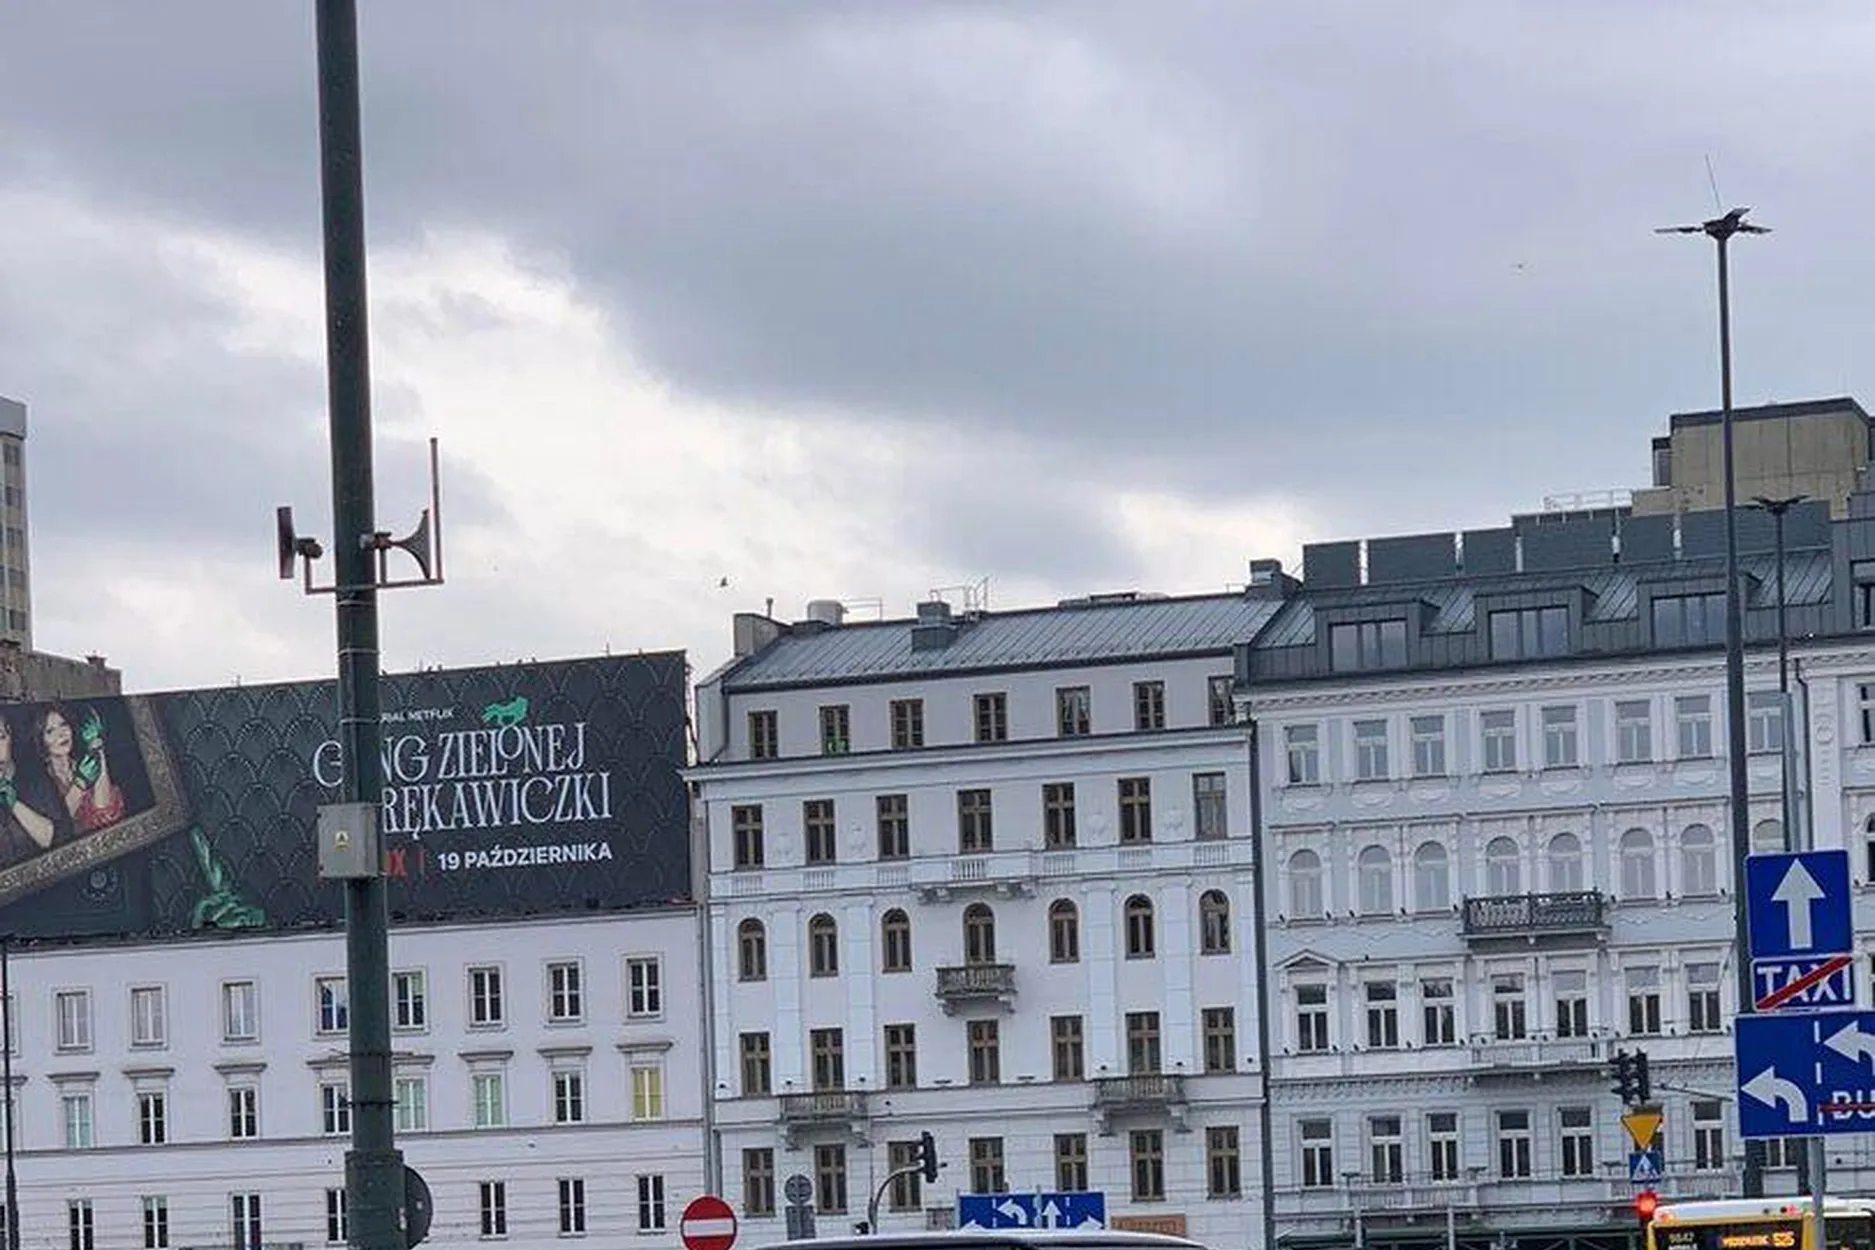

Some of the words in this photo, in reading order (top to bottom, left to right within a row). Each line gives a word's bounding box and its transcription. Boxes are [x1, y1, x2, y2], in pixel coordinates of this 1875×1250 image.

[313, 735, 430, 788] GNG
[438, 721, 587, 779] ZIELONEJ
[381, 772, 612, 840] RĘKAWICZKI
[438, 850, 460, 871] 19
[465, 842, 612, 869] PAŹDZIERNIKA
[1756, 962, 1852, 1002] TAXI
[1832, 1090, 1875, 1120] BU
